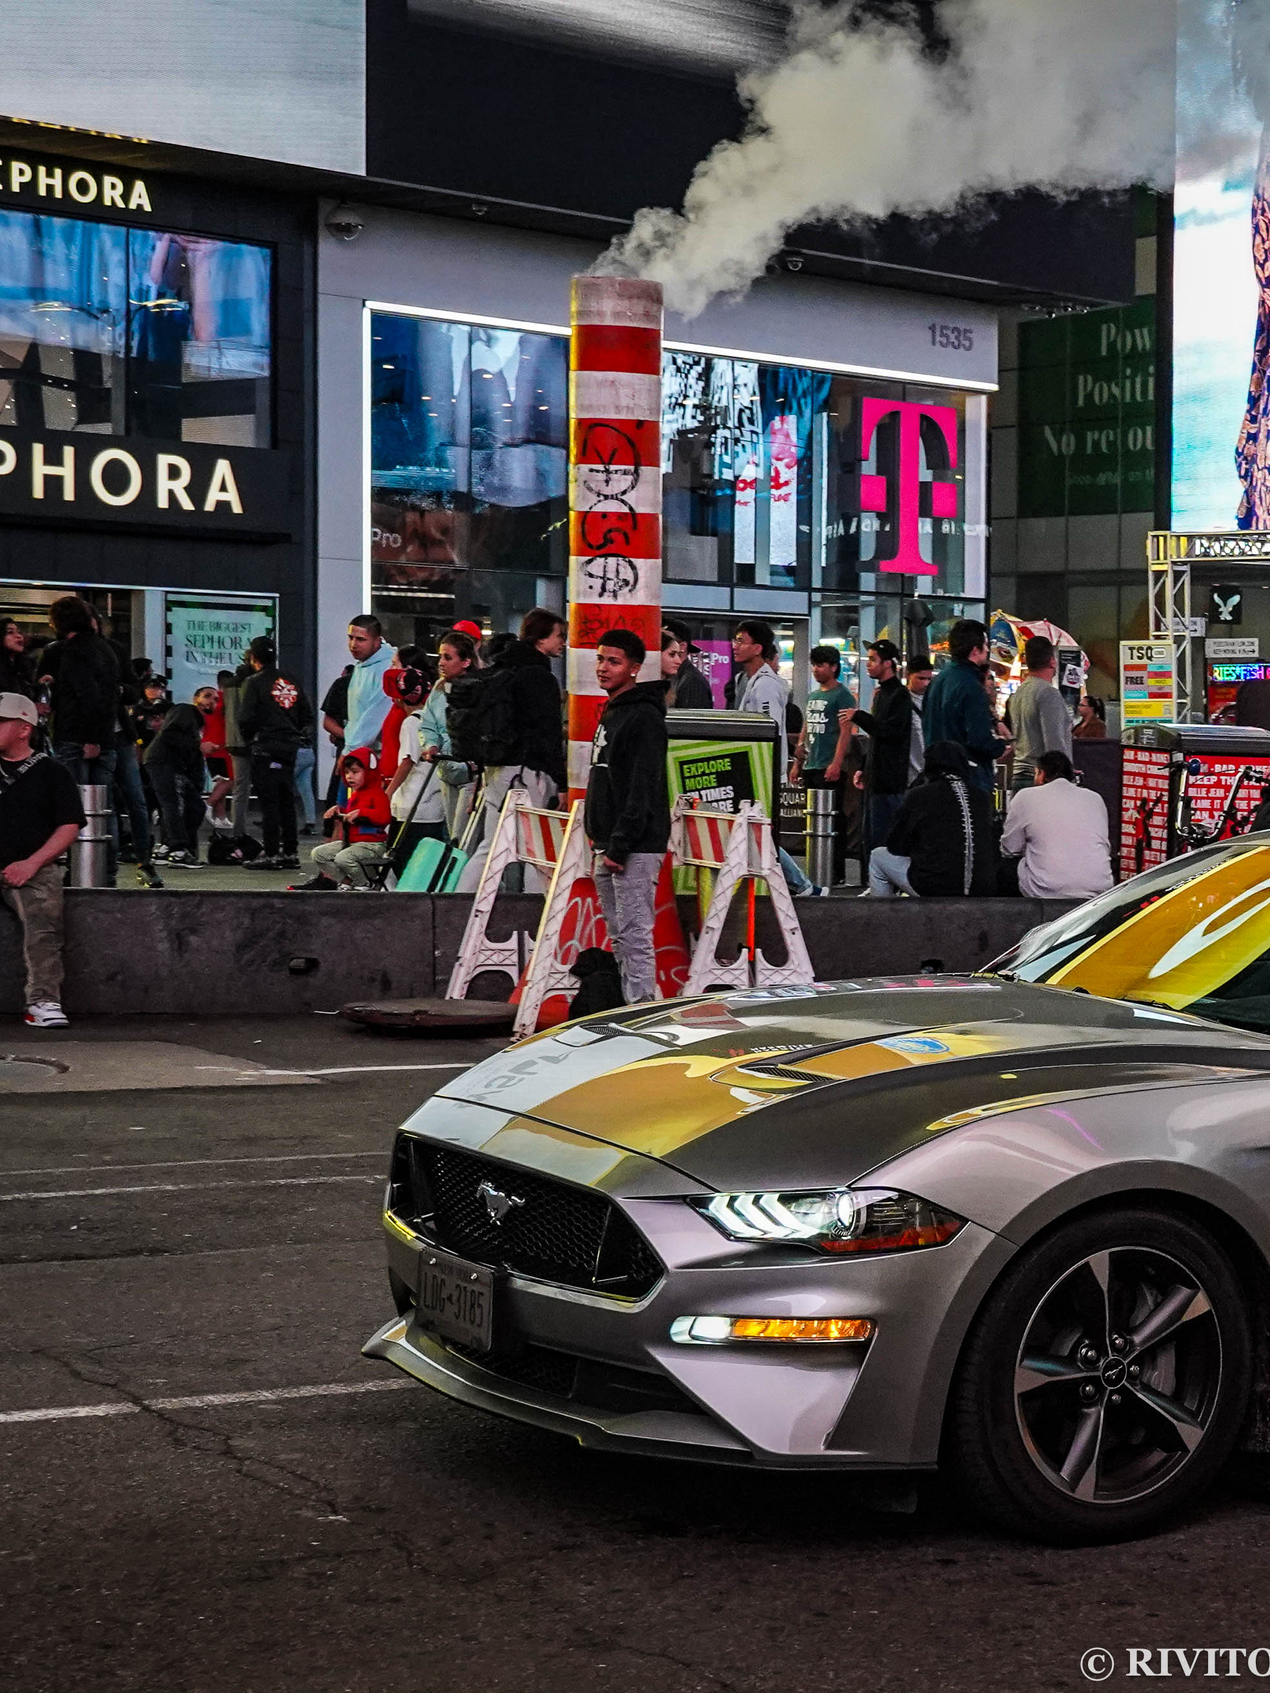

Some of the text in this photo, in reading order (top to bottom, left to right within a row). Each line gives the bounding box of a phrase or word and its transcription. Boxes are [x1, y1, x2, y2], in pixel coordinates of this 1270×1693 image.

[0, 160, 152, 212] PHORA
[928, 323, 974, 352] 1535
[371, 527, 402, 548] Pro
[187, 620, 252, 634] THE BIGGEST
[711, 652, 730, 665] Pro
[1128, 646, 1154, 661] TSQ
[1125, 676, 1144, 685] FREE
[683, 758, 732, 777] EXPLORE
[684, 774, 717, 791] MORE
[701, 786, 735, 802] TIMES
